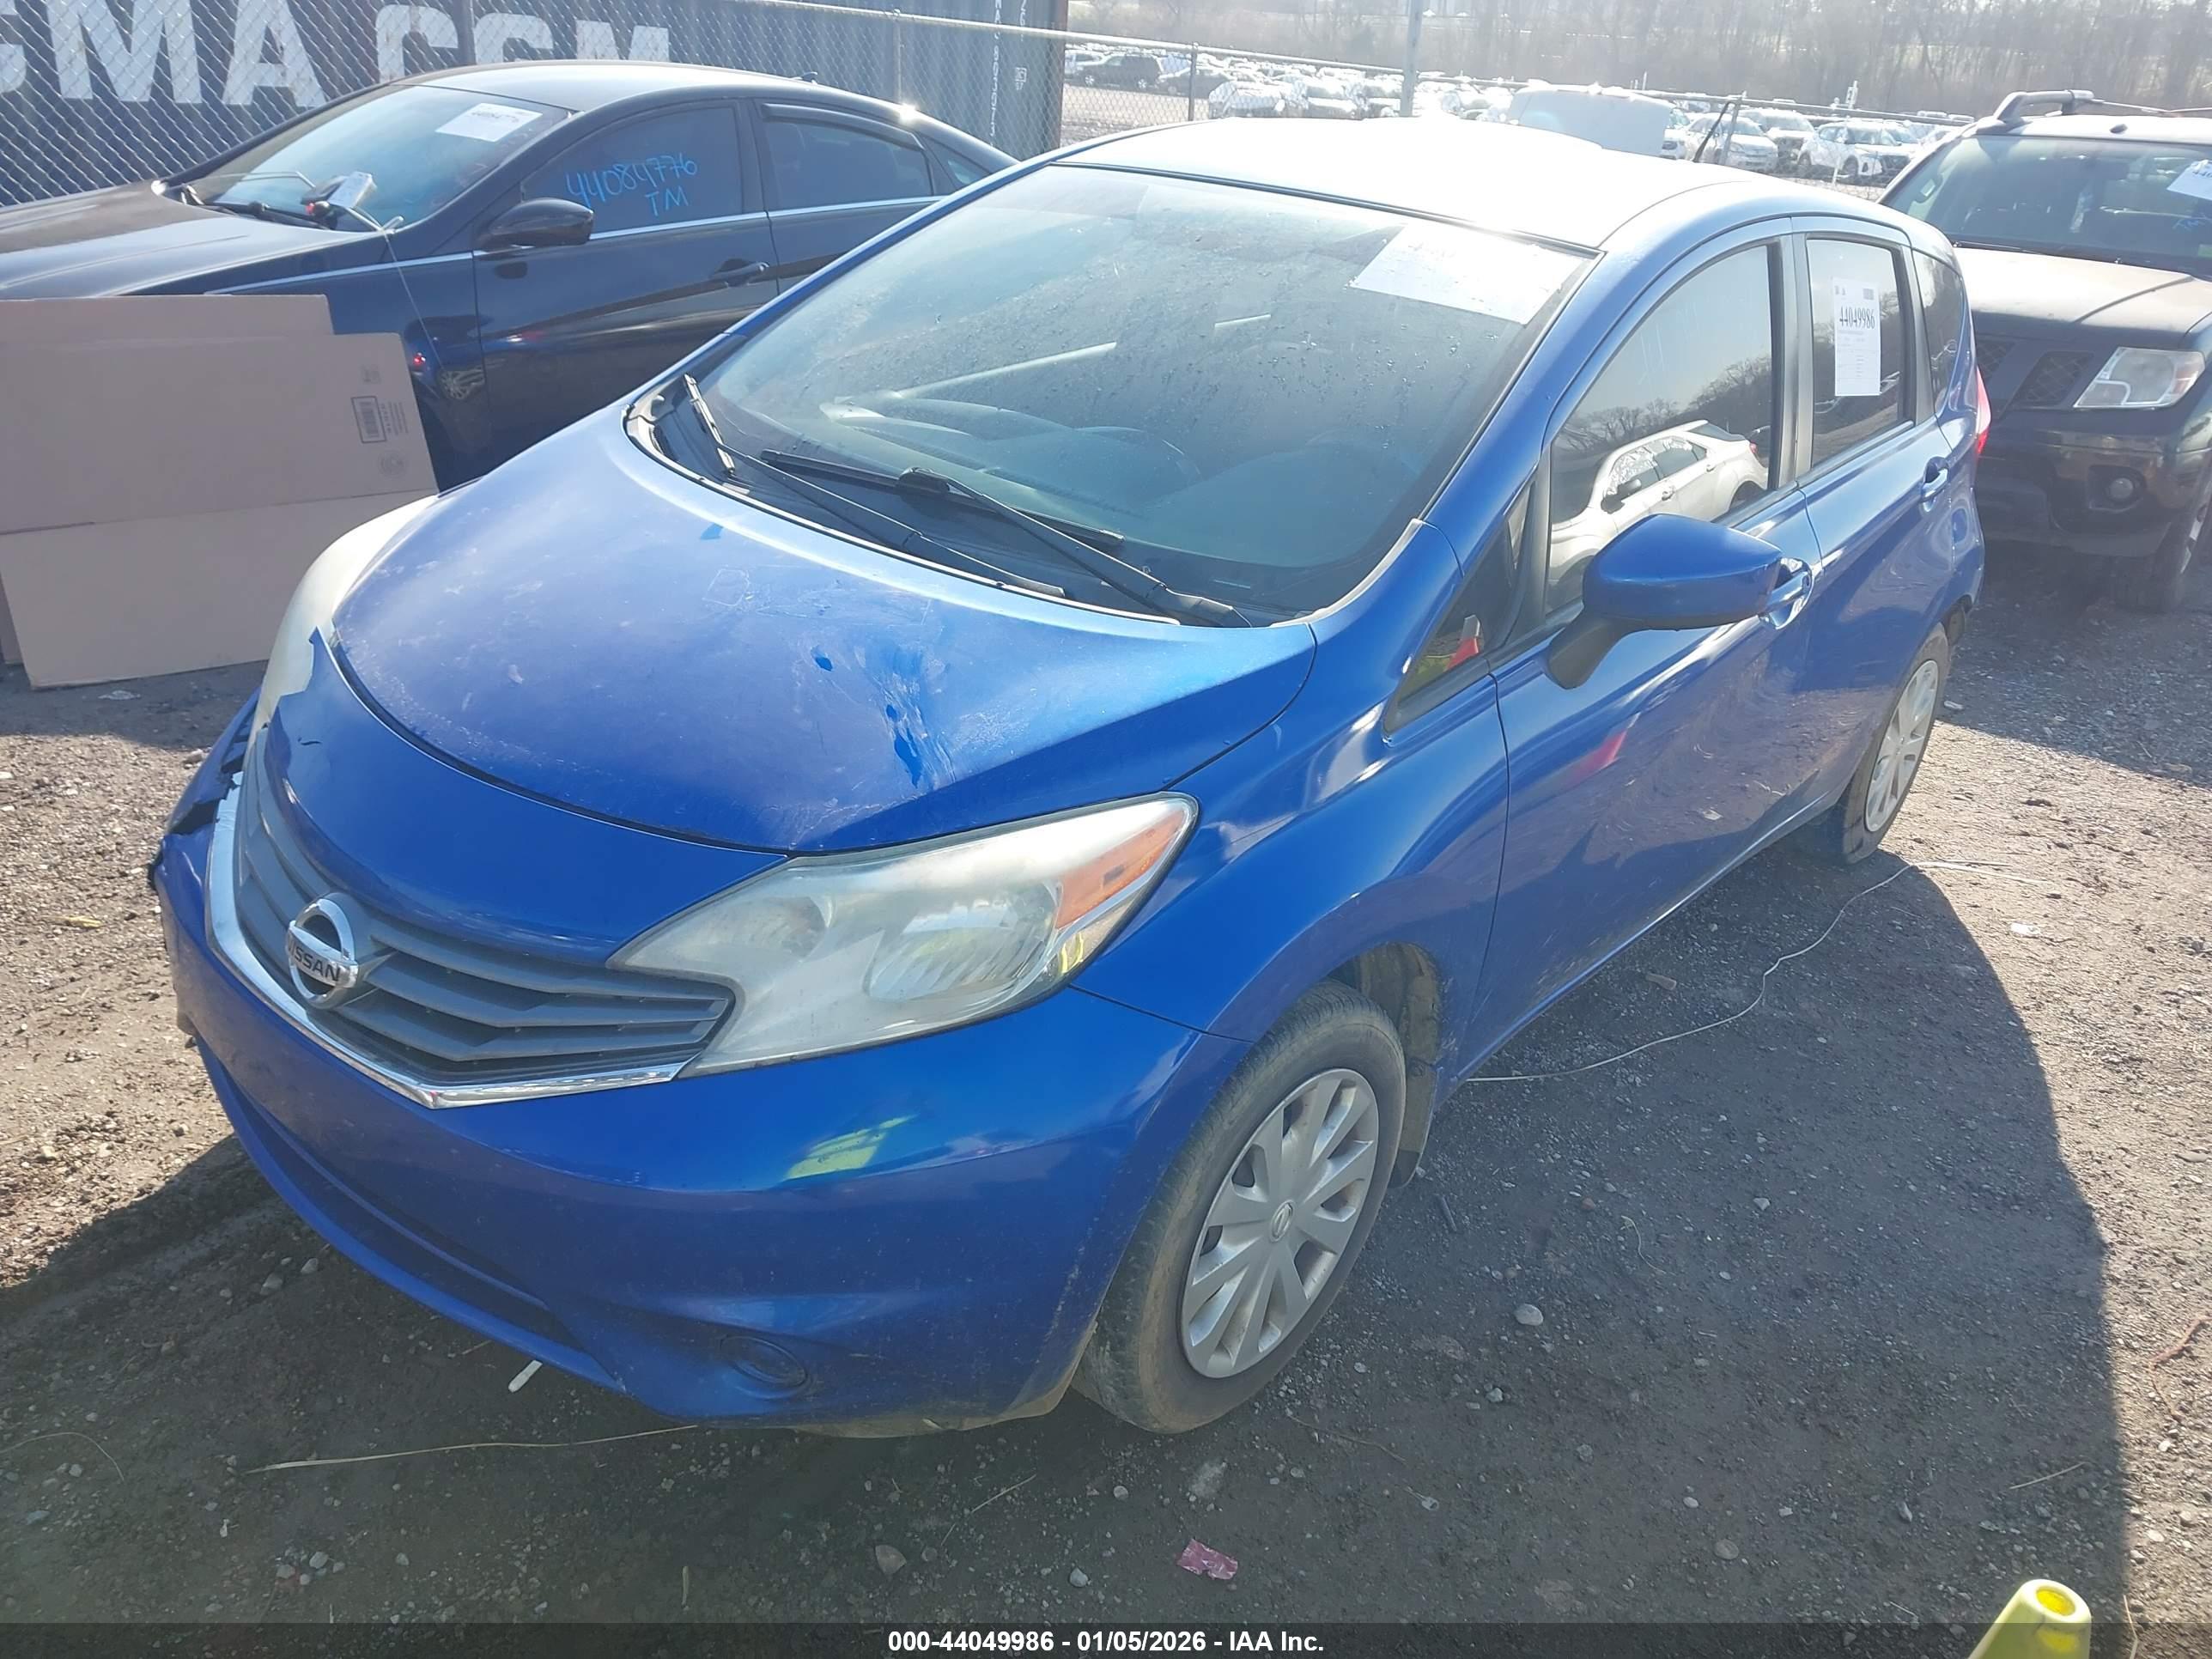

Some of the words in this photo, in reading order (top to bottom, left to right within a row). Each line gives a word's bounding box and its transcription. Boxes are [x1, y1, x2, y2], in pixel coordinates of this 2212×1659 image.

[0, 0, 327, 107] MA
[645, 185, 689, 216] TM
[1839, 306, 1875, 329] 44049986
